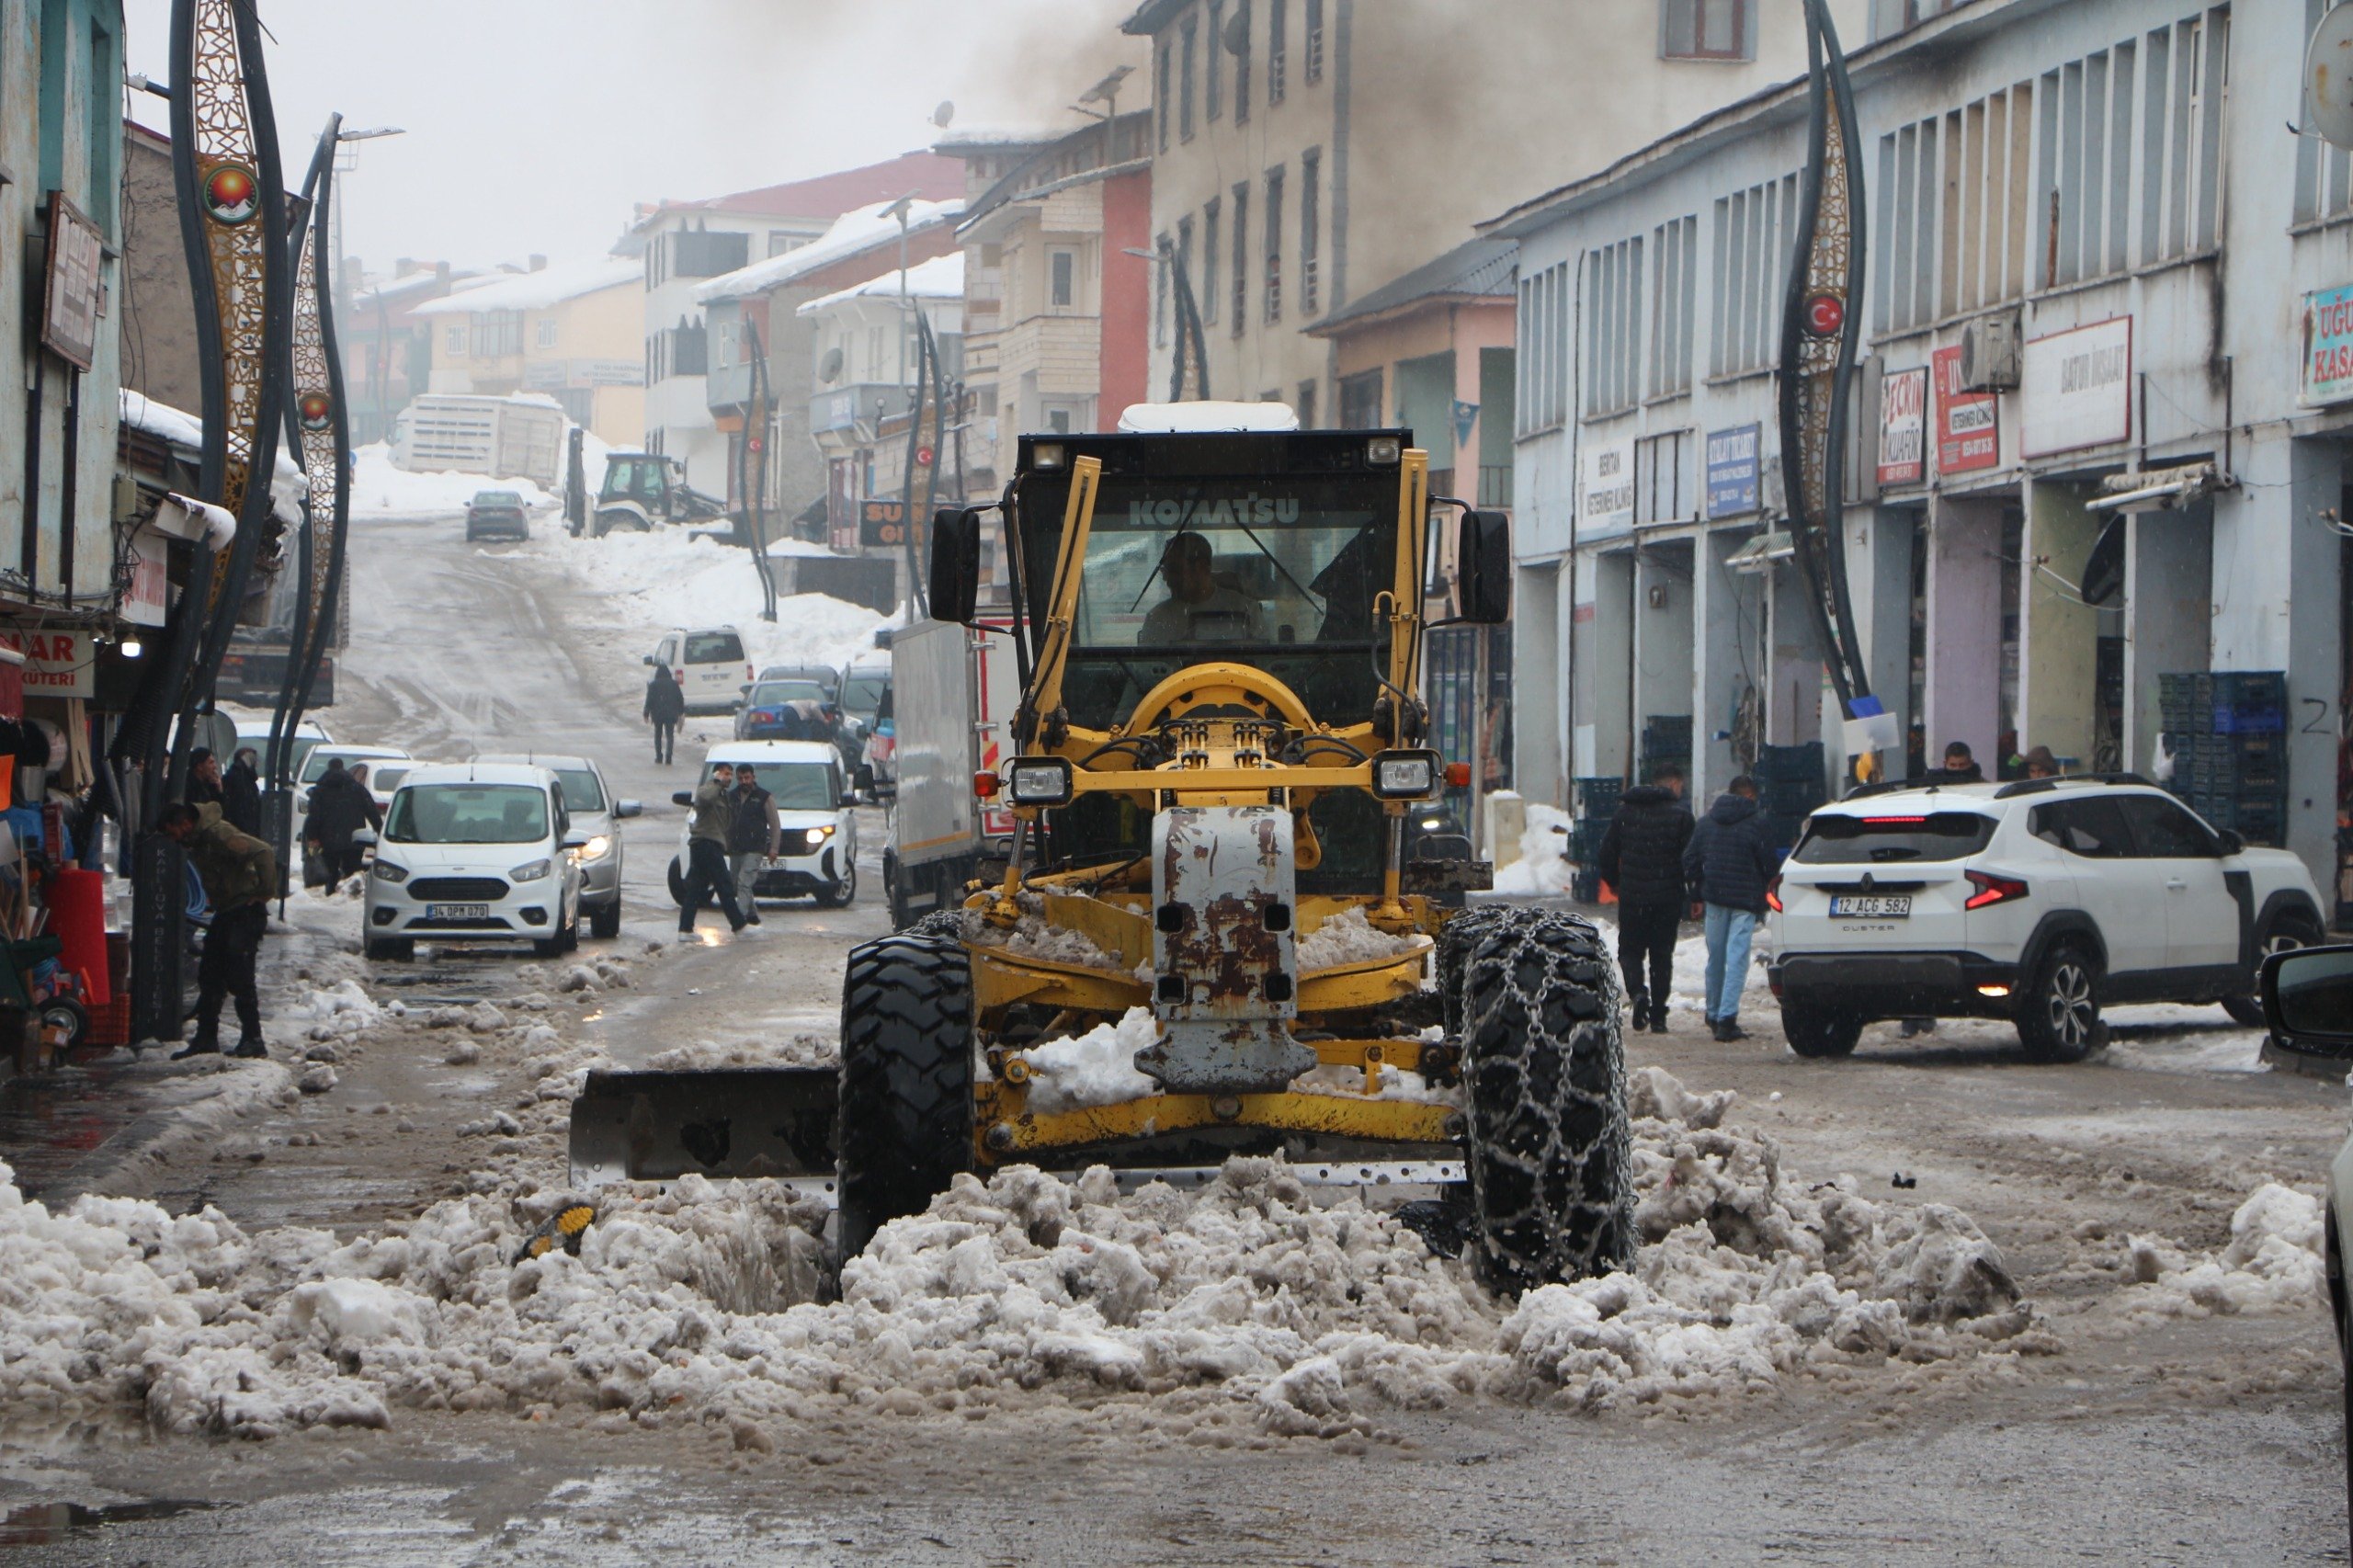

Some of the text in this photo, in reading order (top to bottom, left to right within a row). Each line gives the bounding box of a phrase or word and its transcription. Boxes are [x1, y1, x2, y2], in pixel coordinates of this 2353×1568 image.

[1130, 492, 1299, 525] KOMATSU
[2301, 698, 2331, 733] 2
[433, 906, 444, 916] 34
[1839, 898, 1907, 913] 12 ACG 582
